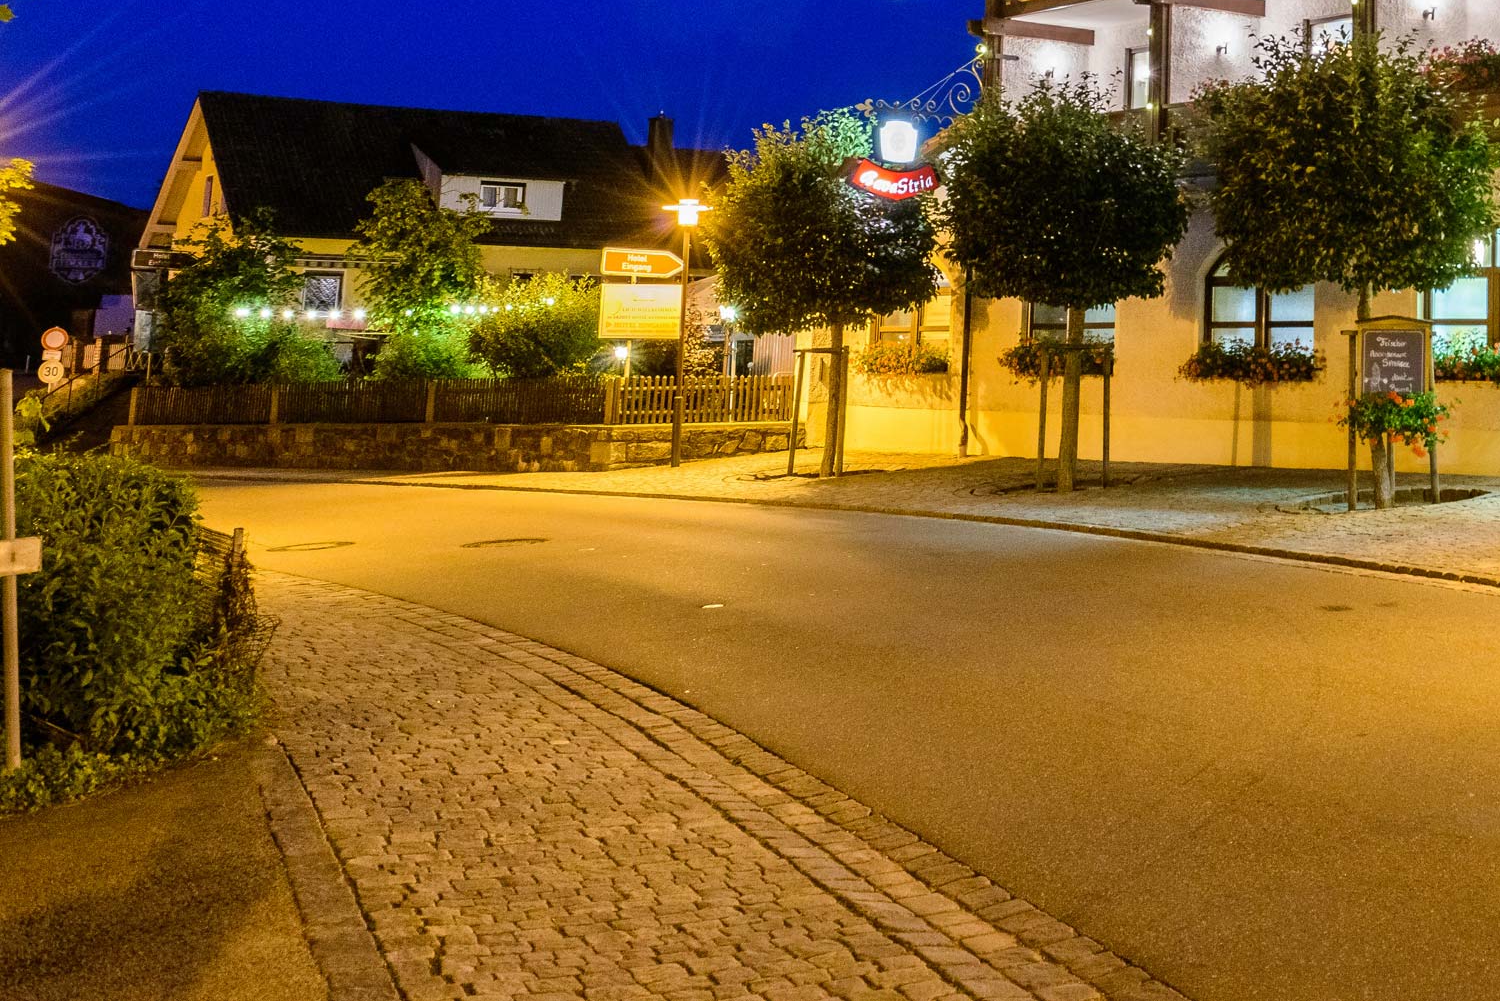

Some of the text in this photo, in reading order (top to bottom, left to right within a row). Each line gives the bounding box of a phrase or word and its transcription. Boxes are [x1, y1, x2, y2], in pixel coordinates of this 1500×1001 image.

[860, 170, 934, 195] BavaStria
[622, 262, 652, 272] Eingang
[44, 366, 58, 378] 30
